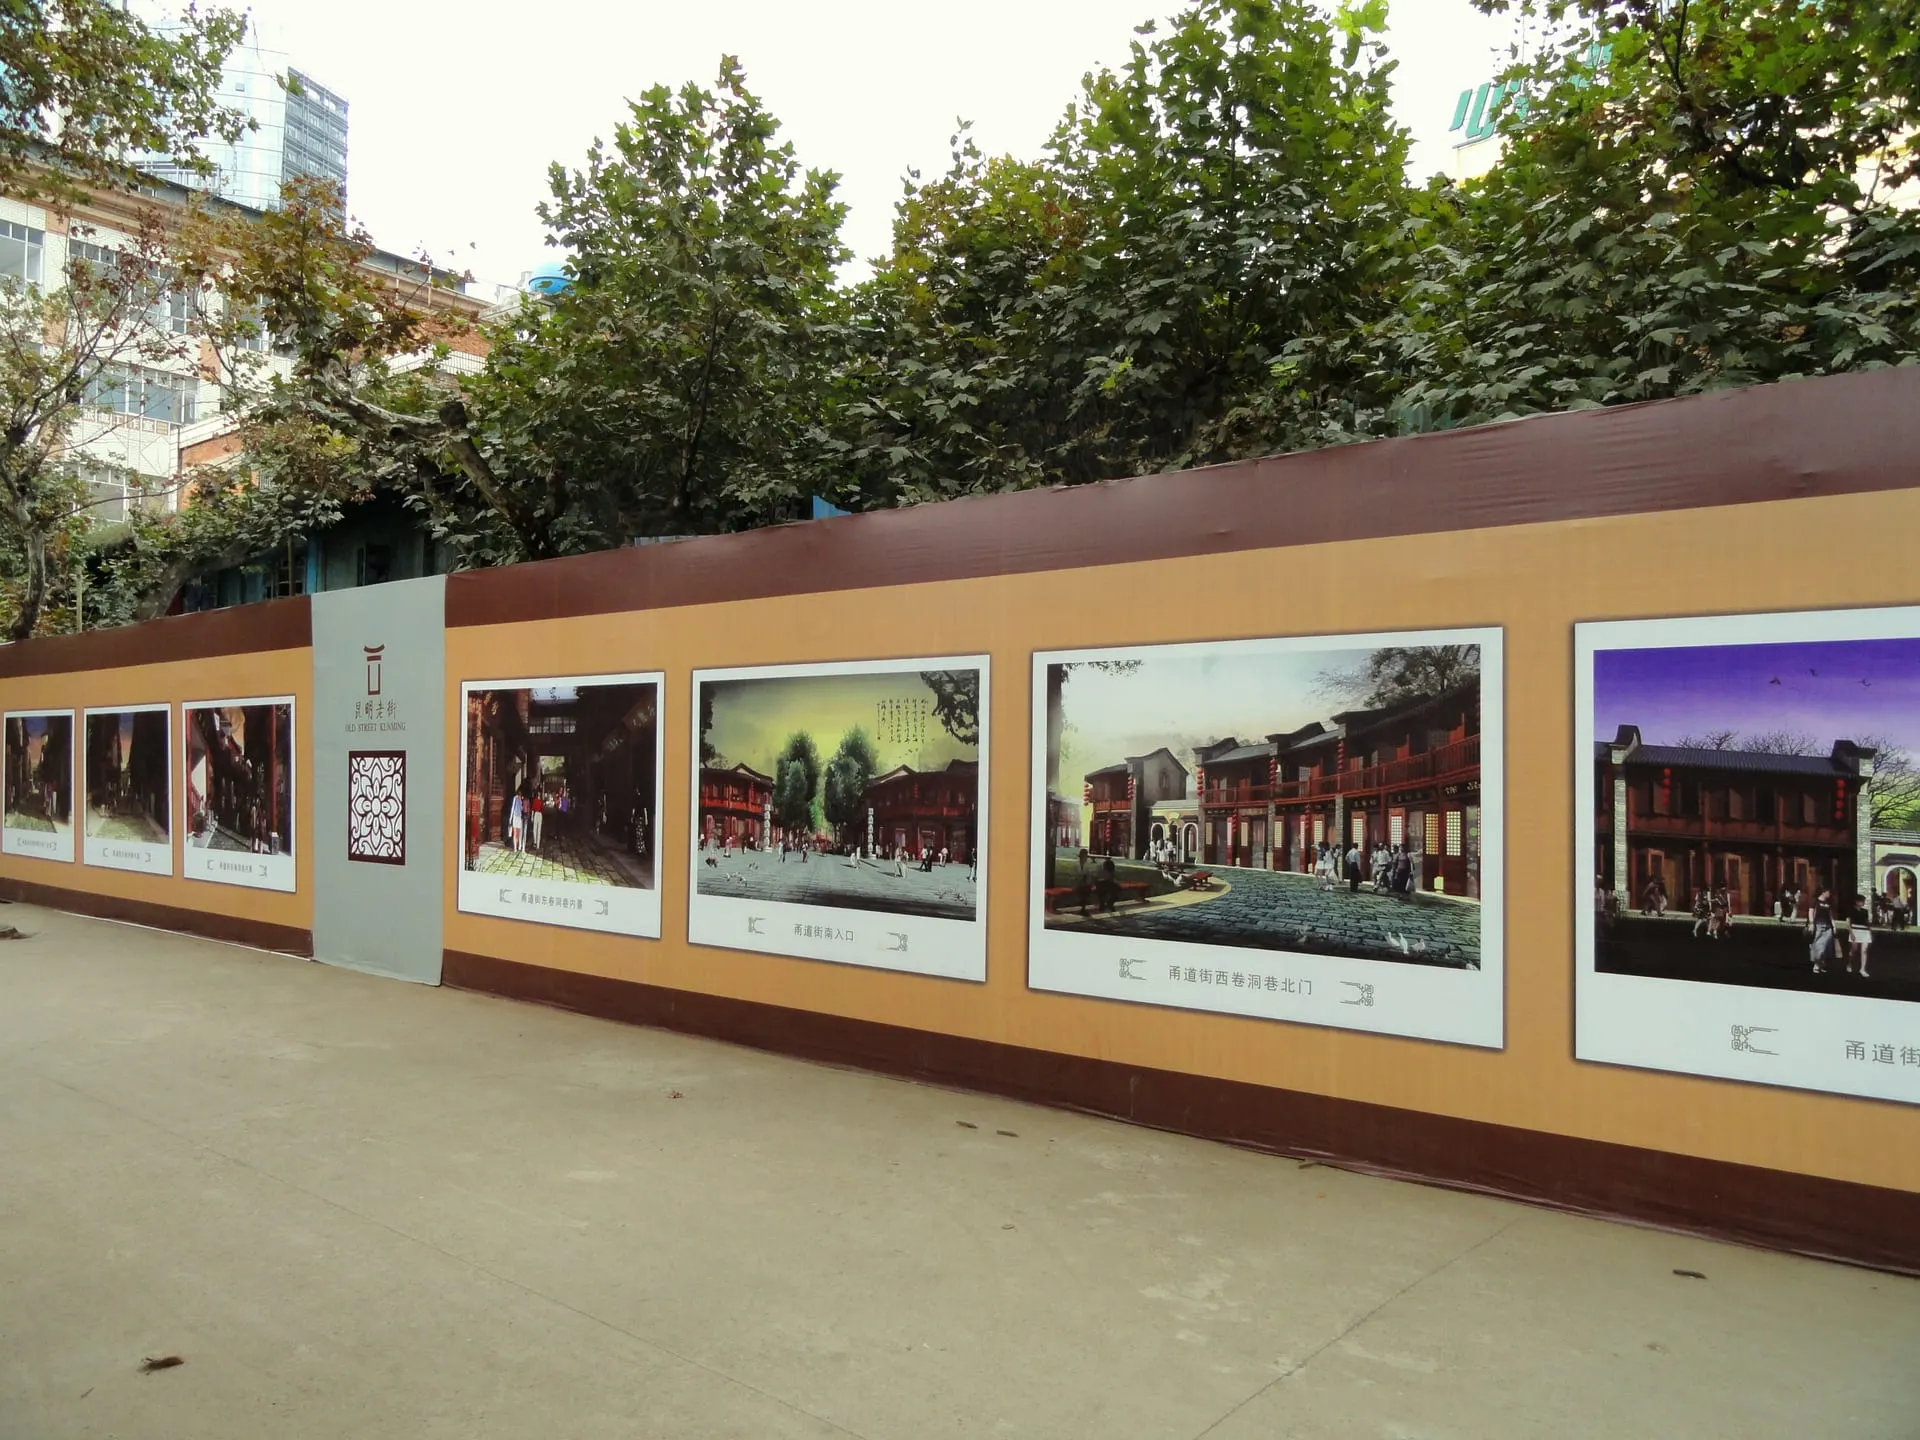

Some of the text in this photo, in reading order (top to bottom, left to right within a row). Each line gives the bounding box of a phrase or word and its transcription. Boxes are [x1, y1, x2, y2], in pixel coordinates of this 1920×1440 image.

[355, 698, 398, 720] 昆明老街
[345, 721, 406, 732] OLD STREET KUNMING
[794, 923, 854, 941] 甬道街南入口
[1169, 965, 1312, 995] 甬道街西卷洞巷北门
[1845, 1039, 1920, 1067] 甬道街
